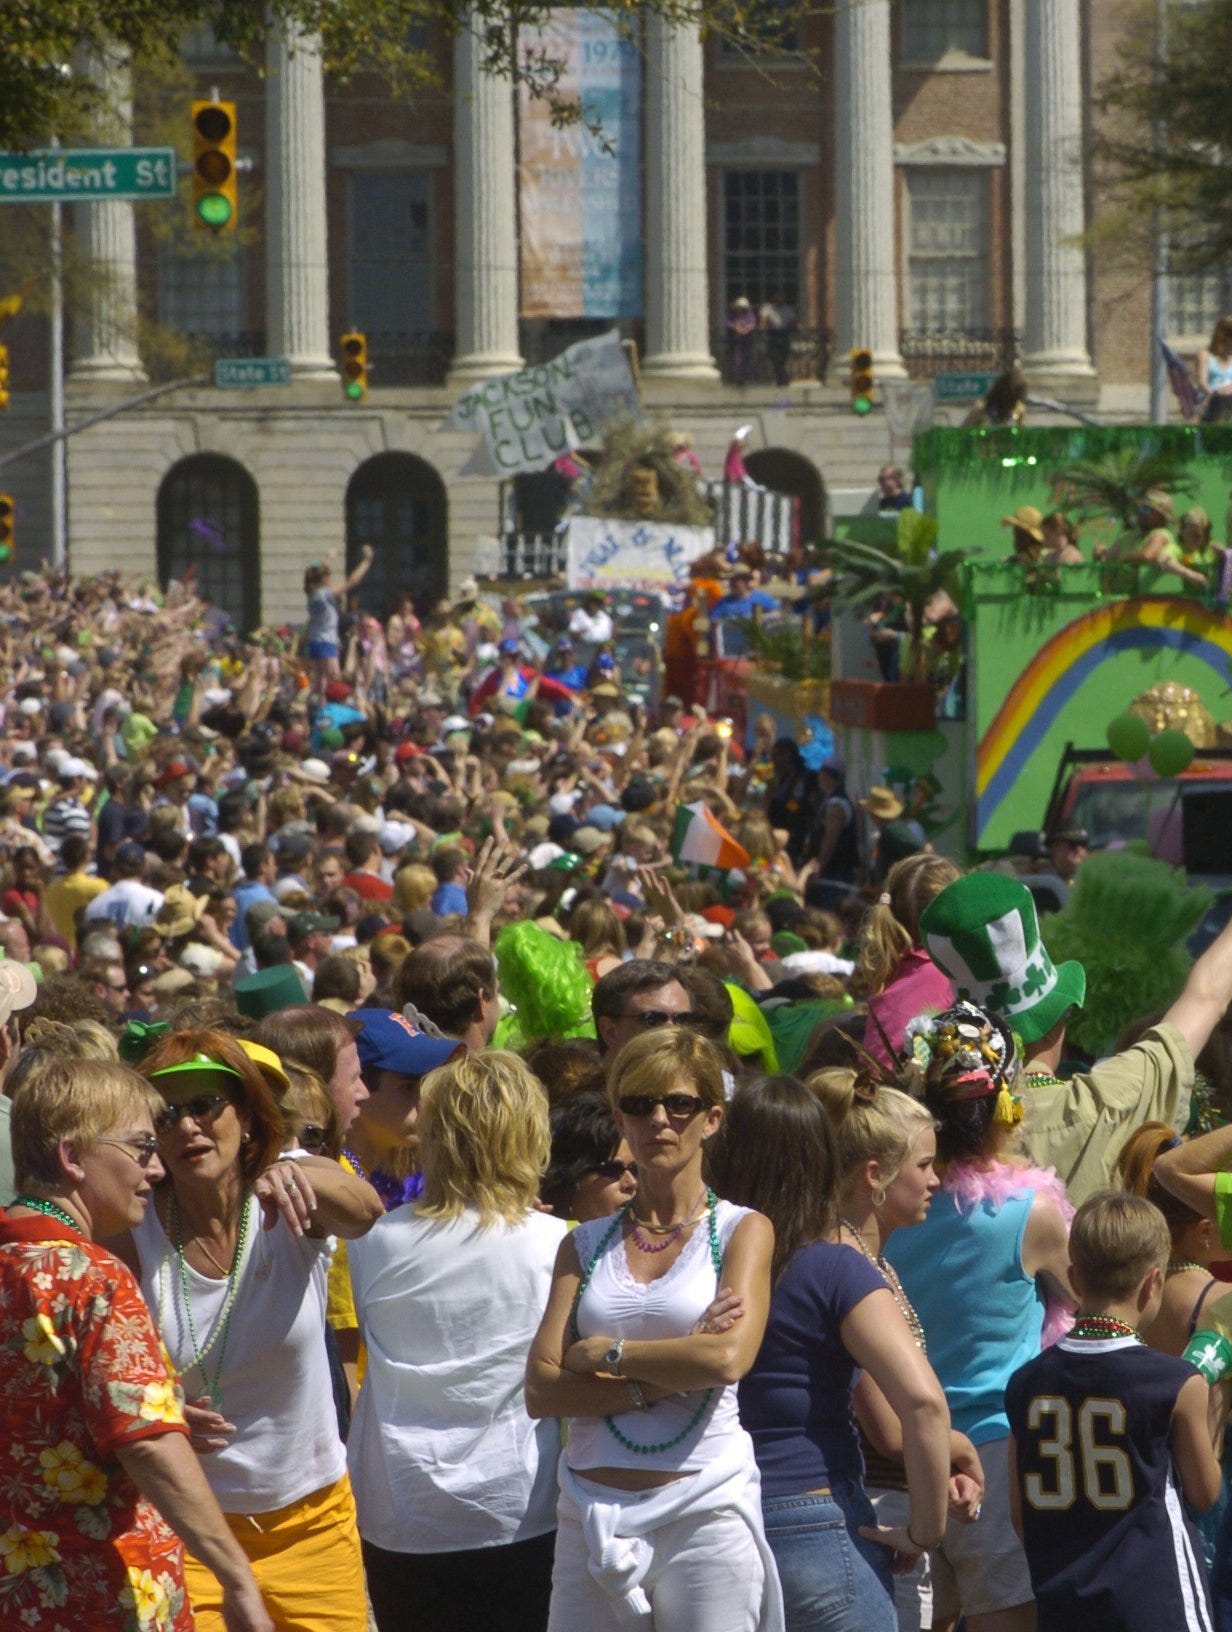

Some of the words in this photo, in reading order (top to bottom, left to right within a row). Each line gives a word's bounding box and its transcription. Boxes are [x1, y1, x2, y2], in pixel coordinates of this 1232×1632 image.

[0, 159, 117, 190] esident
[136, 159, 168, 188] St
[458, 355, 572, 419] JACKSON
[488, 387, 557, 440] FUN
[495, 409, 595, 468] CLUB
[1024, 1395, 1135, 1511] 36
